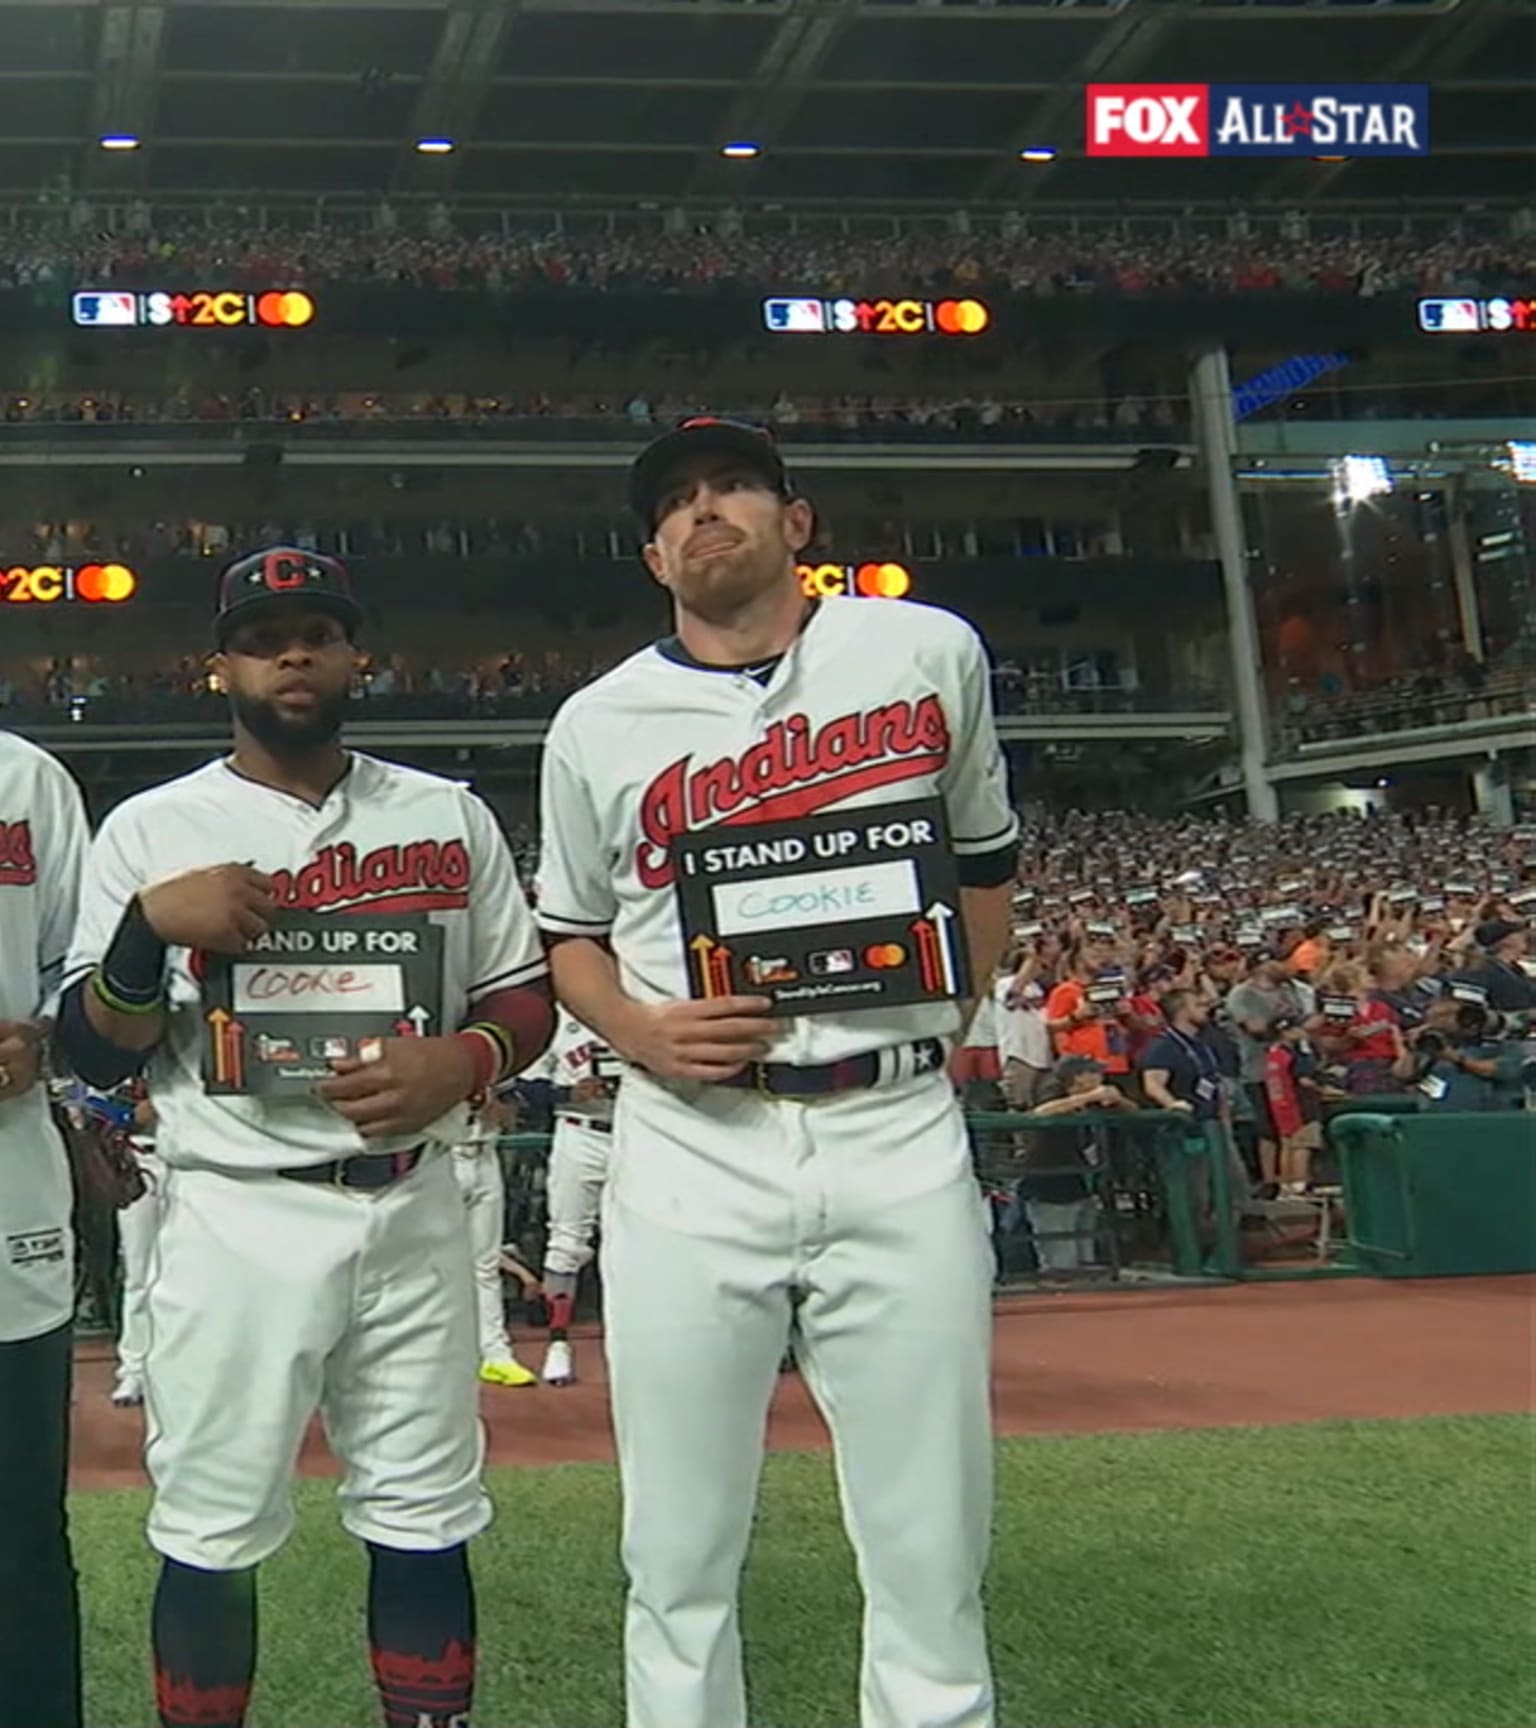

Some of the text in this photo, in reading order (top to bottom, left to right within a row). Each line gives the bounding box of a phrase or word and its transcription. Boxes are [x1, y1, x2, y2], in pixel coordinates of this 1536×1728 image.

[636, 693, 952, 888] Indians
[684, 820, 934, 875] I STAND UP FOR
[268, 838, 470, 914] ndians
[737, 883, 876, 919] COOKIE
[246, 930, 418, 953] AND UP FOR
